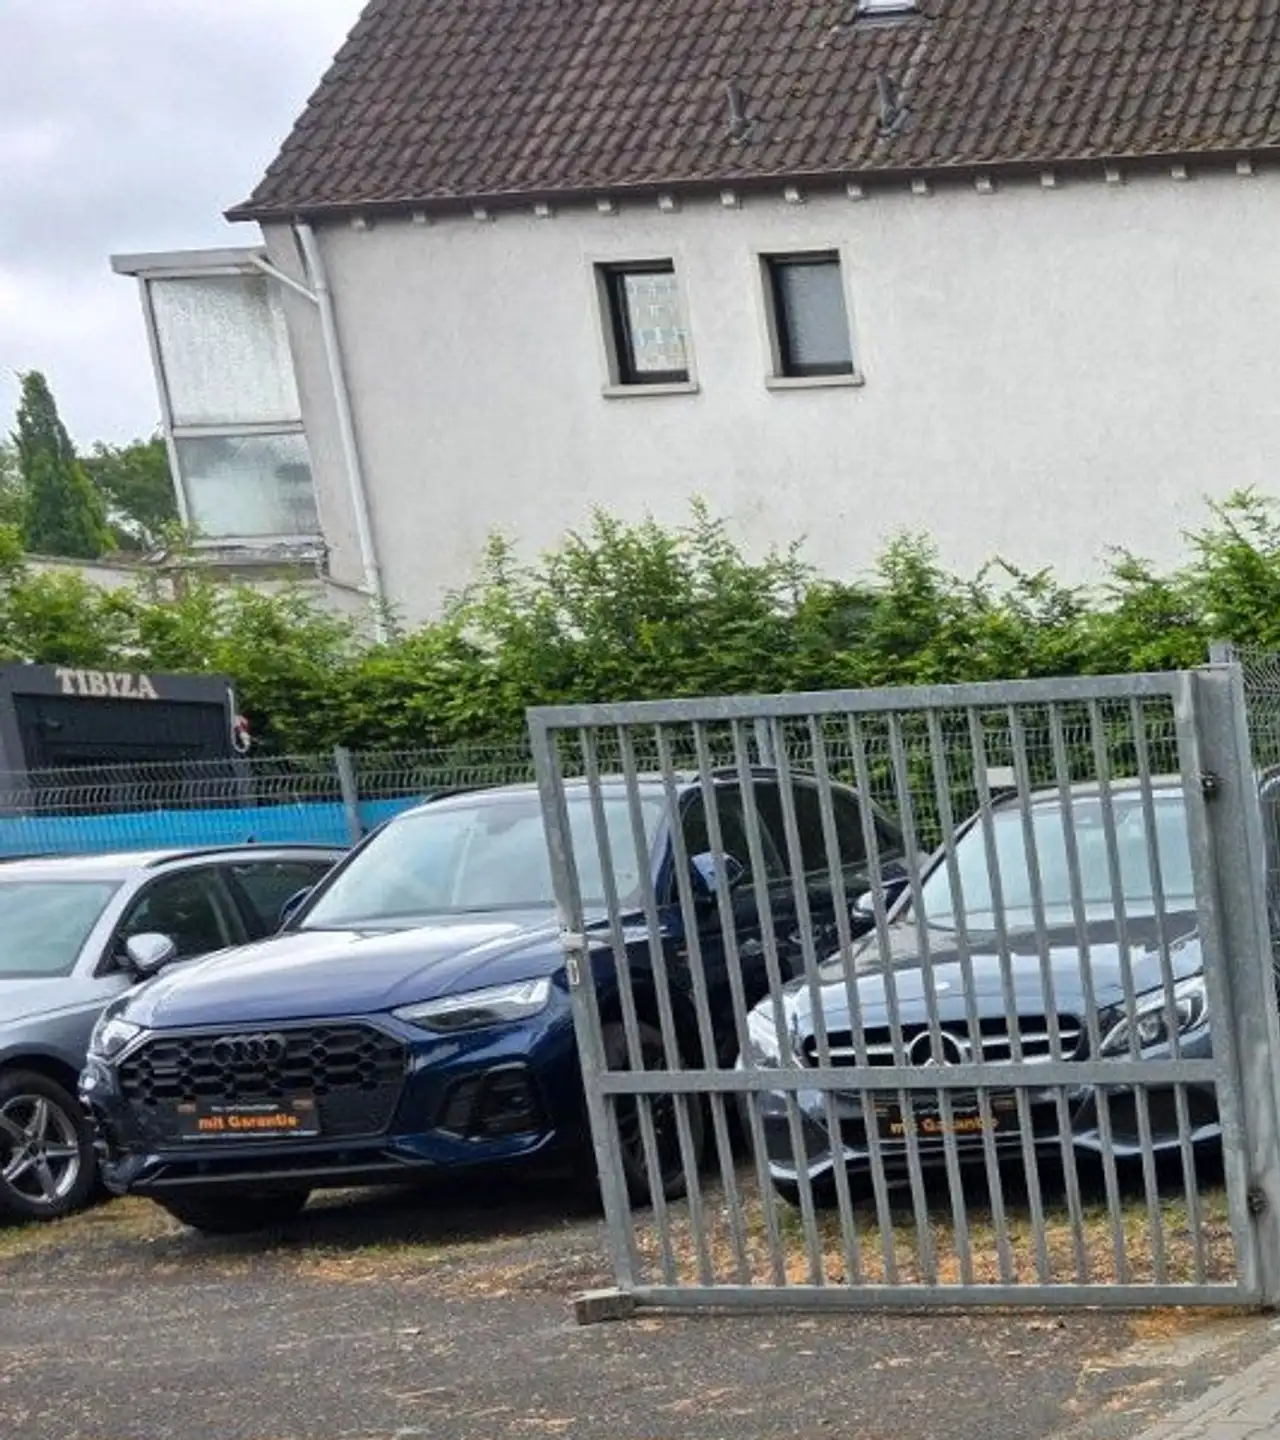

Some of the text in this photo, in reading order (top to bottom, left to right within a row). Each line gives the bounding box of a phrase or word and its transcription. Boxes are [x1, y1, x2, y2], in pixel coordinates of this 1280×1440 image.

[55, 667, 160, 699] TIBIZA
[198, 1113, 298, 1130] mit Garantie
